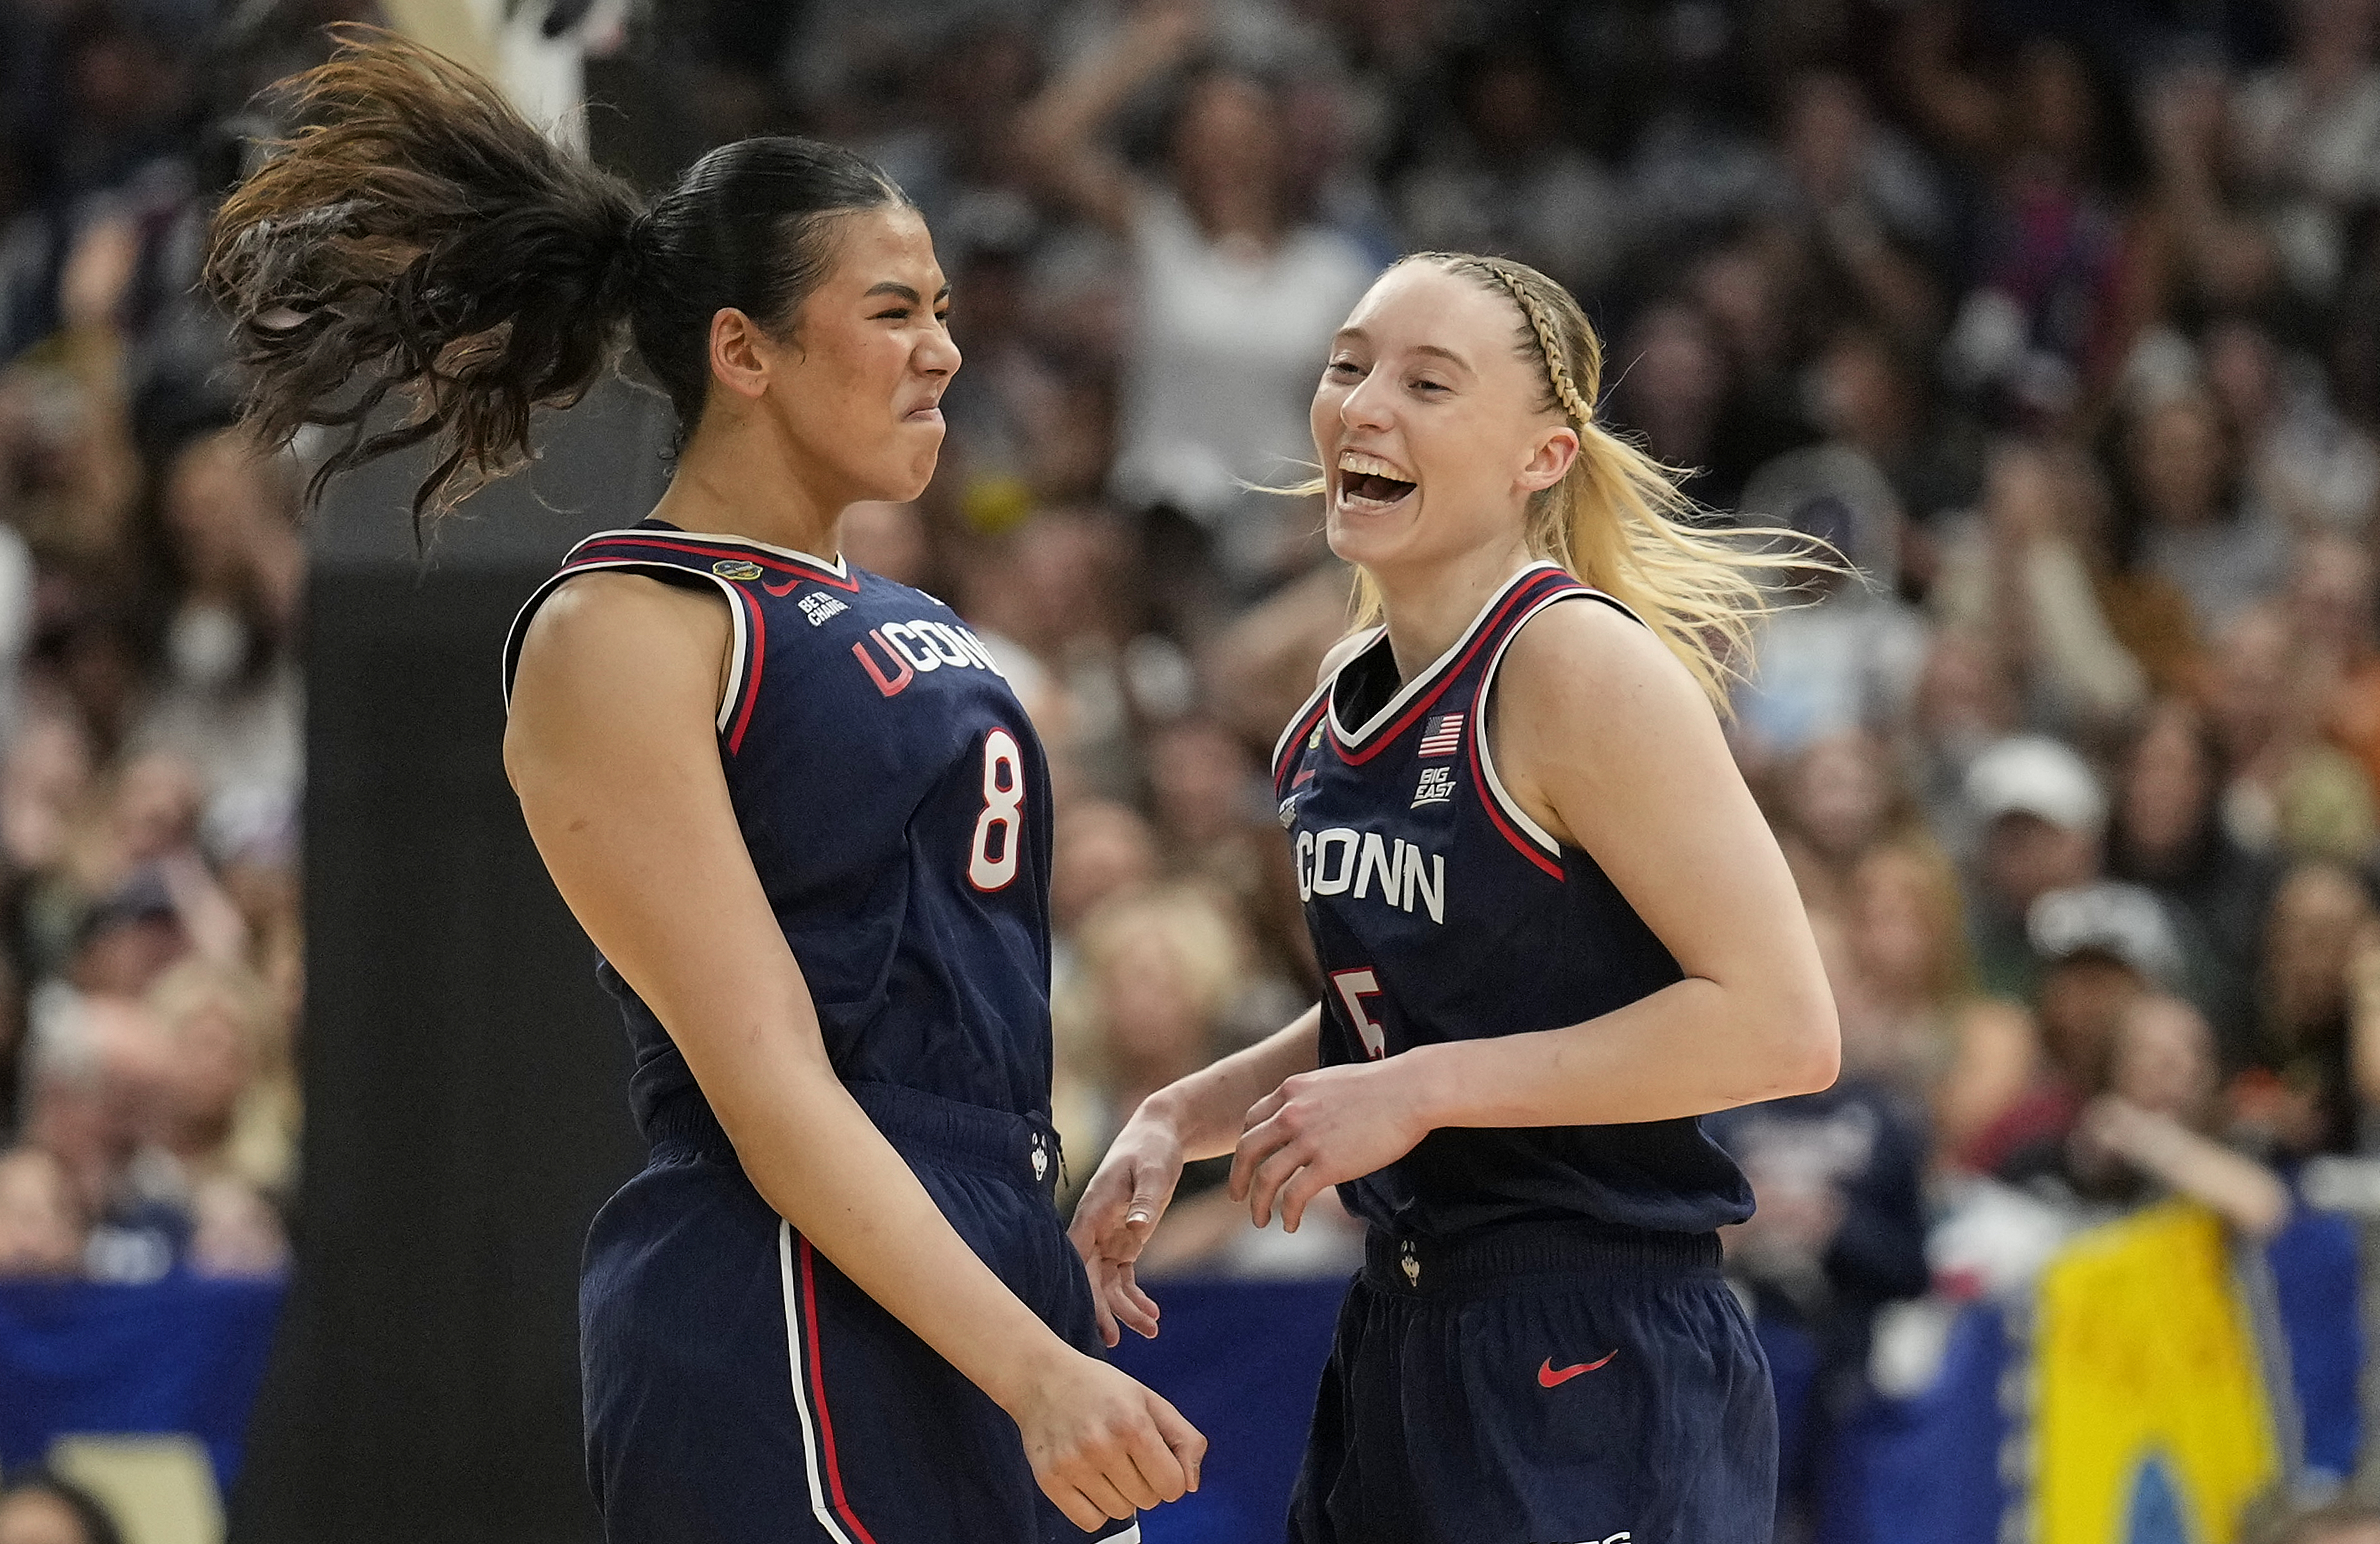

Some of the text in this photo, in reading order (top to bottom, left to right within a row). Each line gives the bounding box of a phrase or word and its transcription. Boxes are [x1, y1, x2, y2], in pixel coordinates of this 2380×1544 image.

[798, 591, 834, 613] BE TH
[808, 599, 850, 626] CHANG
[852, 620, 1004, 697] UCON
[1419, 766, 1450, 784] BIG
[1414, 781, 1456, 800] EAST
[967, 726, 1026, 893] 8
[1296, 828, 1444, 925] CONN
